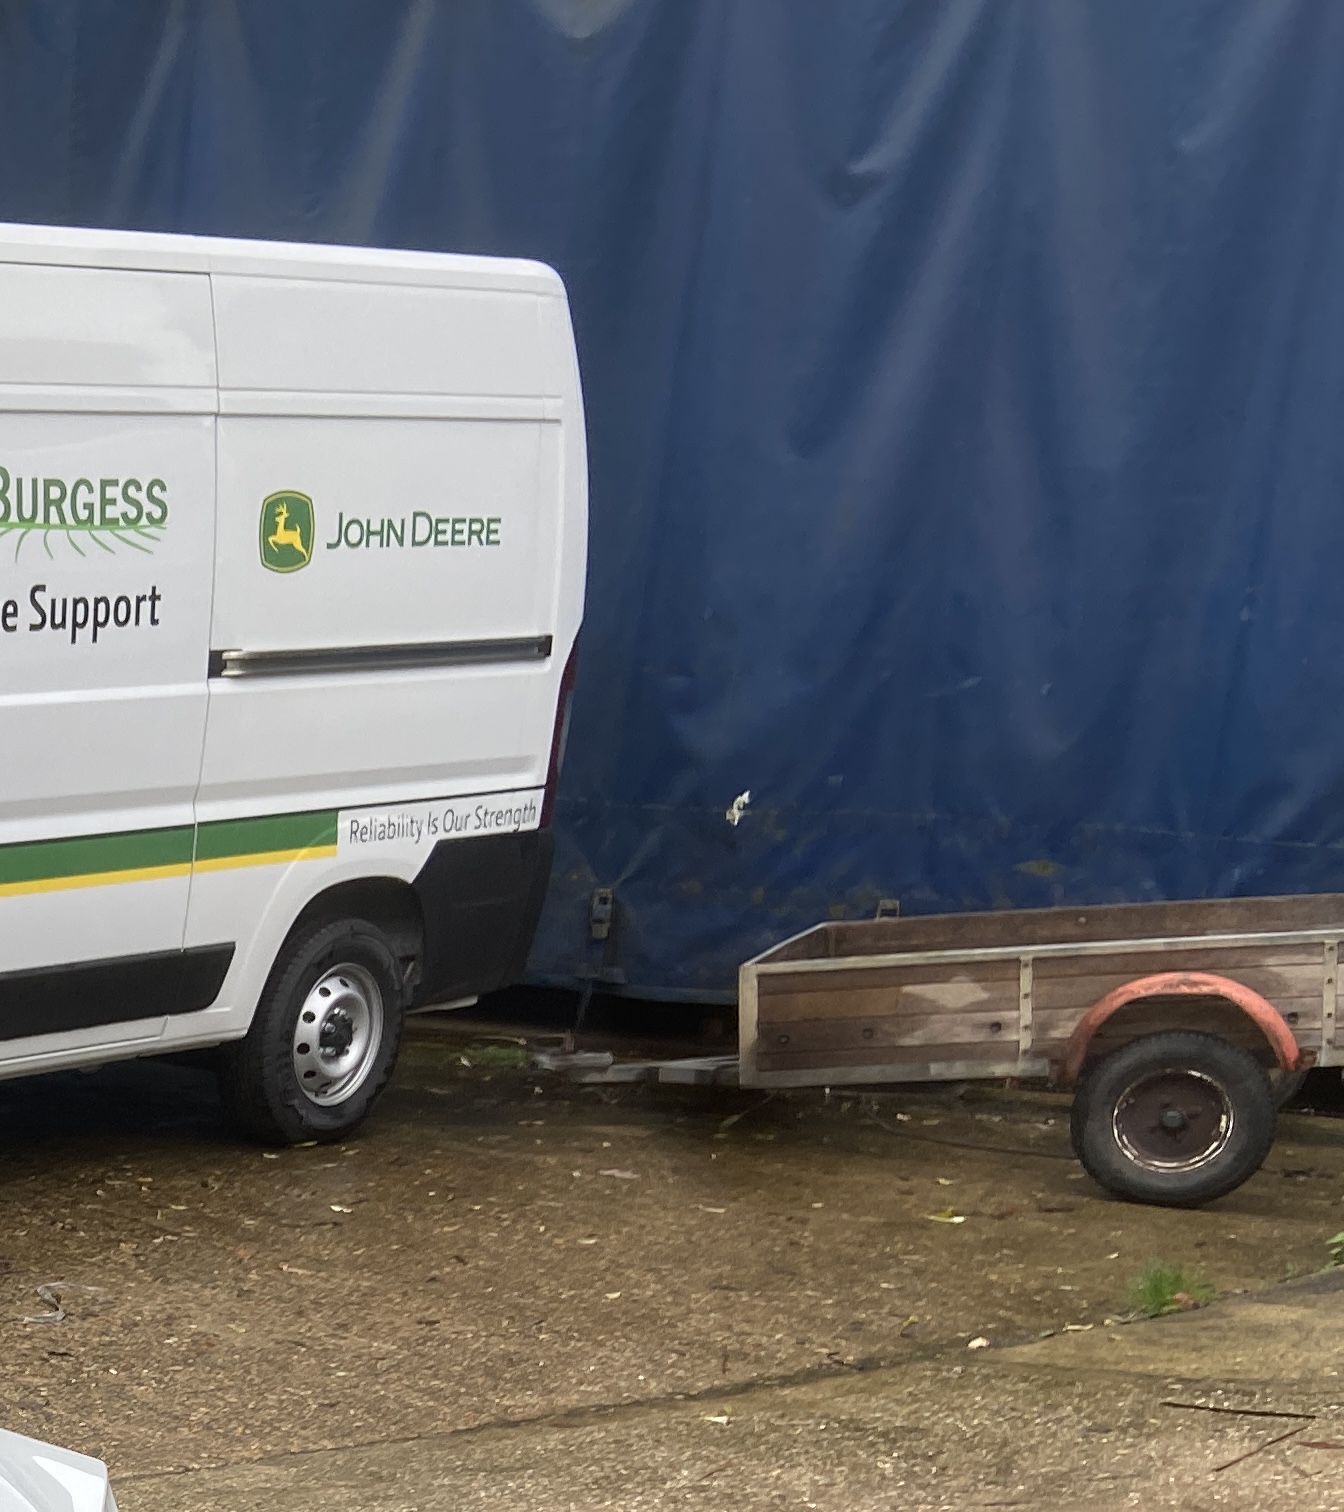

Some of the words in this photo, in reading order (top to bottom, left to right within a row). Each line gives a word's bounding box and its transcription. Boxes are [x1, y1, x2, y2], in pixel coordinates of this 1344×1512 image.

[326, 511, 406, 549] JOHN
[412, 512, 502, 548] DEERE
[28, 584, 162, 644] Support
[349, 813, 423, 845] Reliability
[427, 811, 439, 835] Is
[443, 809, 471, 833] Our
[474, 799, 537, 832] Strength
